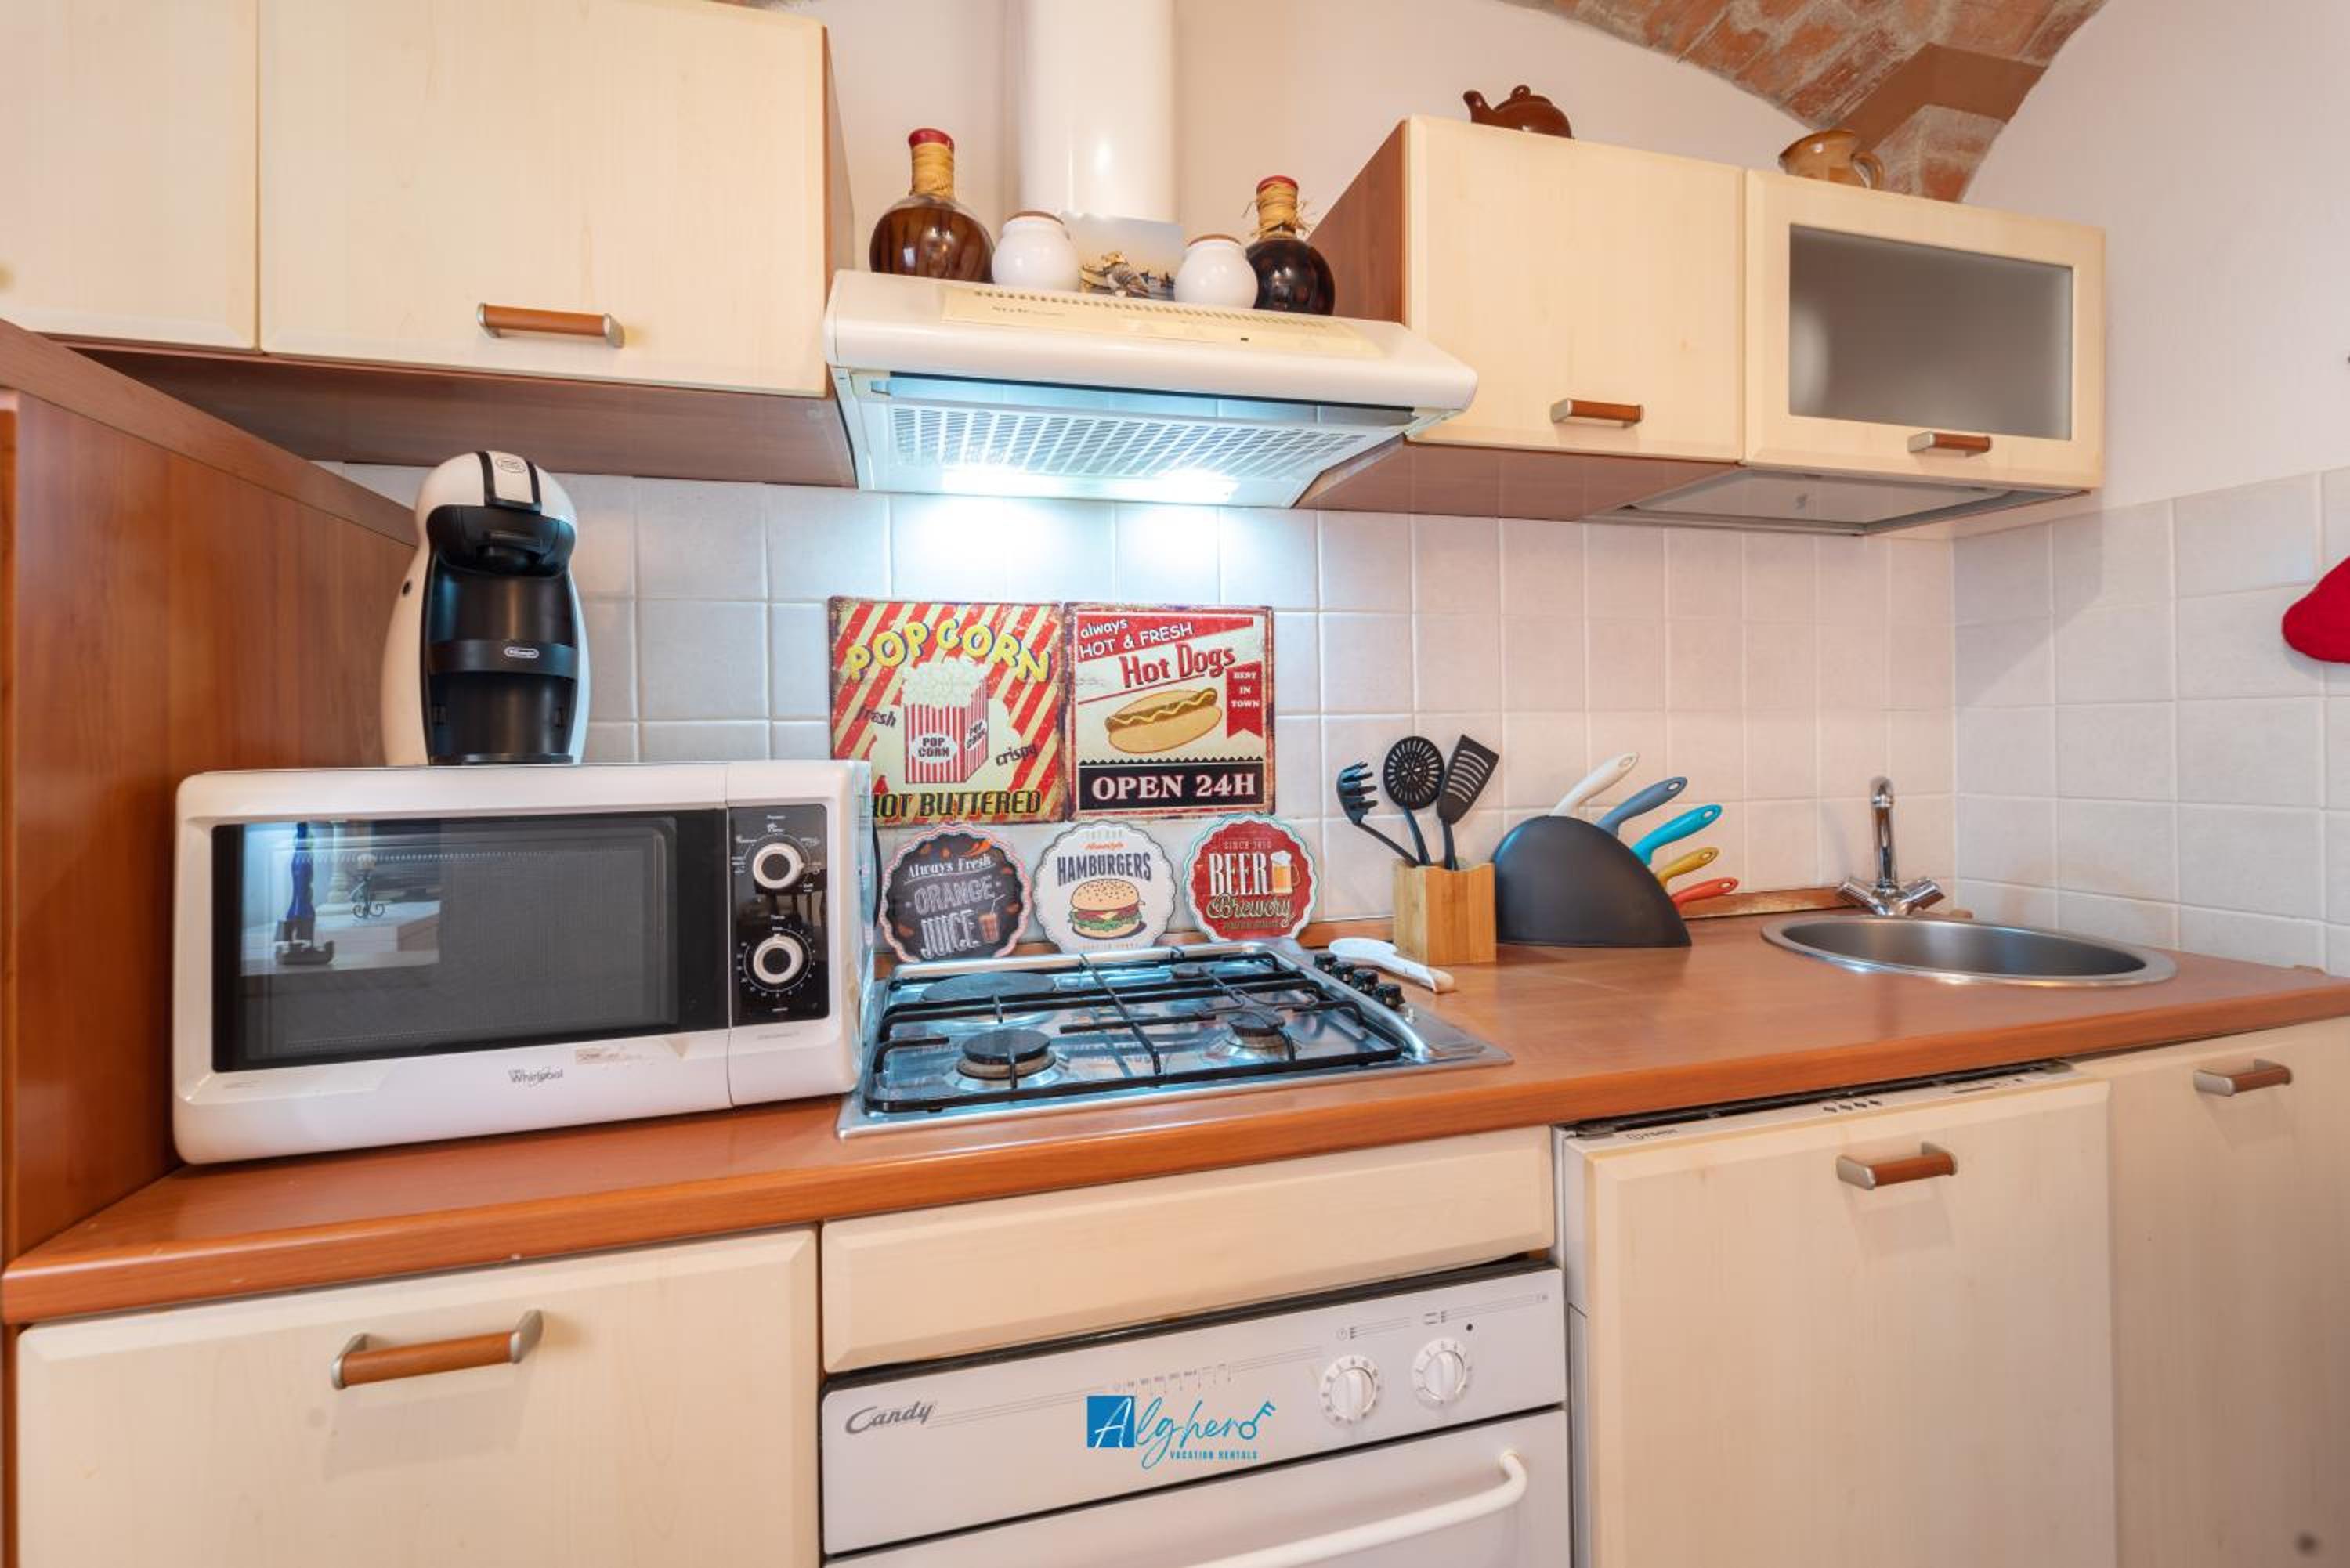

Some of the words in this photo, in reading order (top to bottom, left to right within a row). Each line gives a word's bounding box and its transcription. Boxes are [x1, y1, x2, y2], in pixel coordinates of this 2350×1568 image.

[1078, 638, 1116, 659] HOT
[1123, 634, 1135, 650] &
[1139, 622, 1195, 646] FRESH
[1080, 619, 1128, 639] always
[1118, 654, 1170, 688] Hot
[1176, 641, 1235, 678] Dogs
[1233, 671, 1256, 680] BEST
[1231, 699, 1260, 708] TOWN
[1238, 685, 1252, 695] IN
[918, 747, 950, 757] CORN
[922, 737, 945, 746] POP
[996, 744, 1038, 767] crispy
[1092, 775, 1184, 800] OPEN
[1195, 773, 1256, 797] 24H
[920, 790, 1041, 817] BUTTERED
[909, 862, 953, 878] Always
[958, 854, 992, 872] Fresh
[1057, 852, 1152, 887] HAMBURGERS
[1209, 851, 1269, 897] BEER
[914, 876, 996, 915] ORANGE
[920, 909, 980, 959] JUICE
[845, 1400, 934, 1434] Candy
